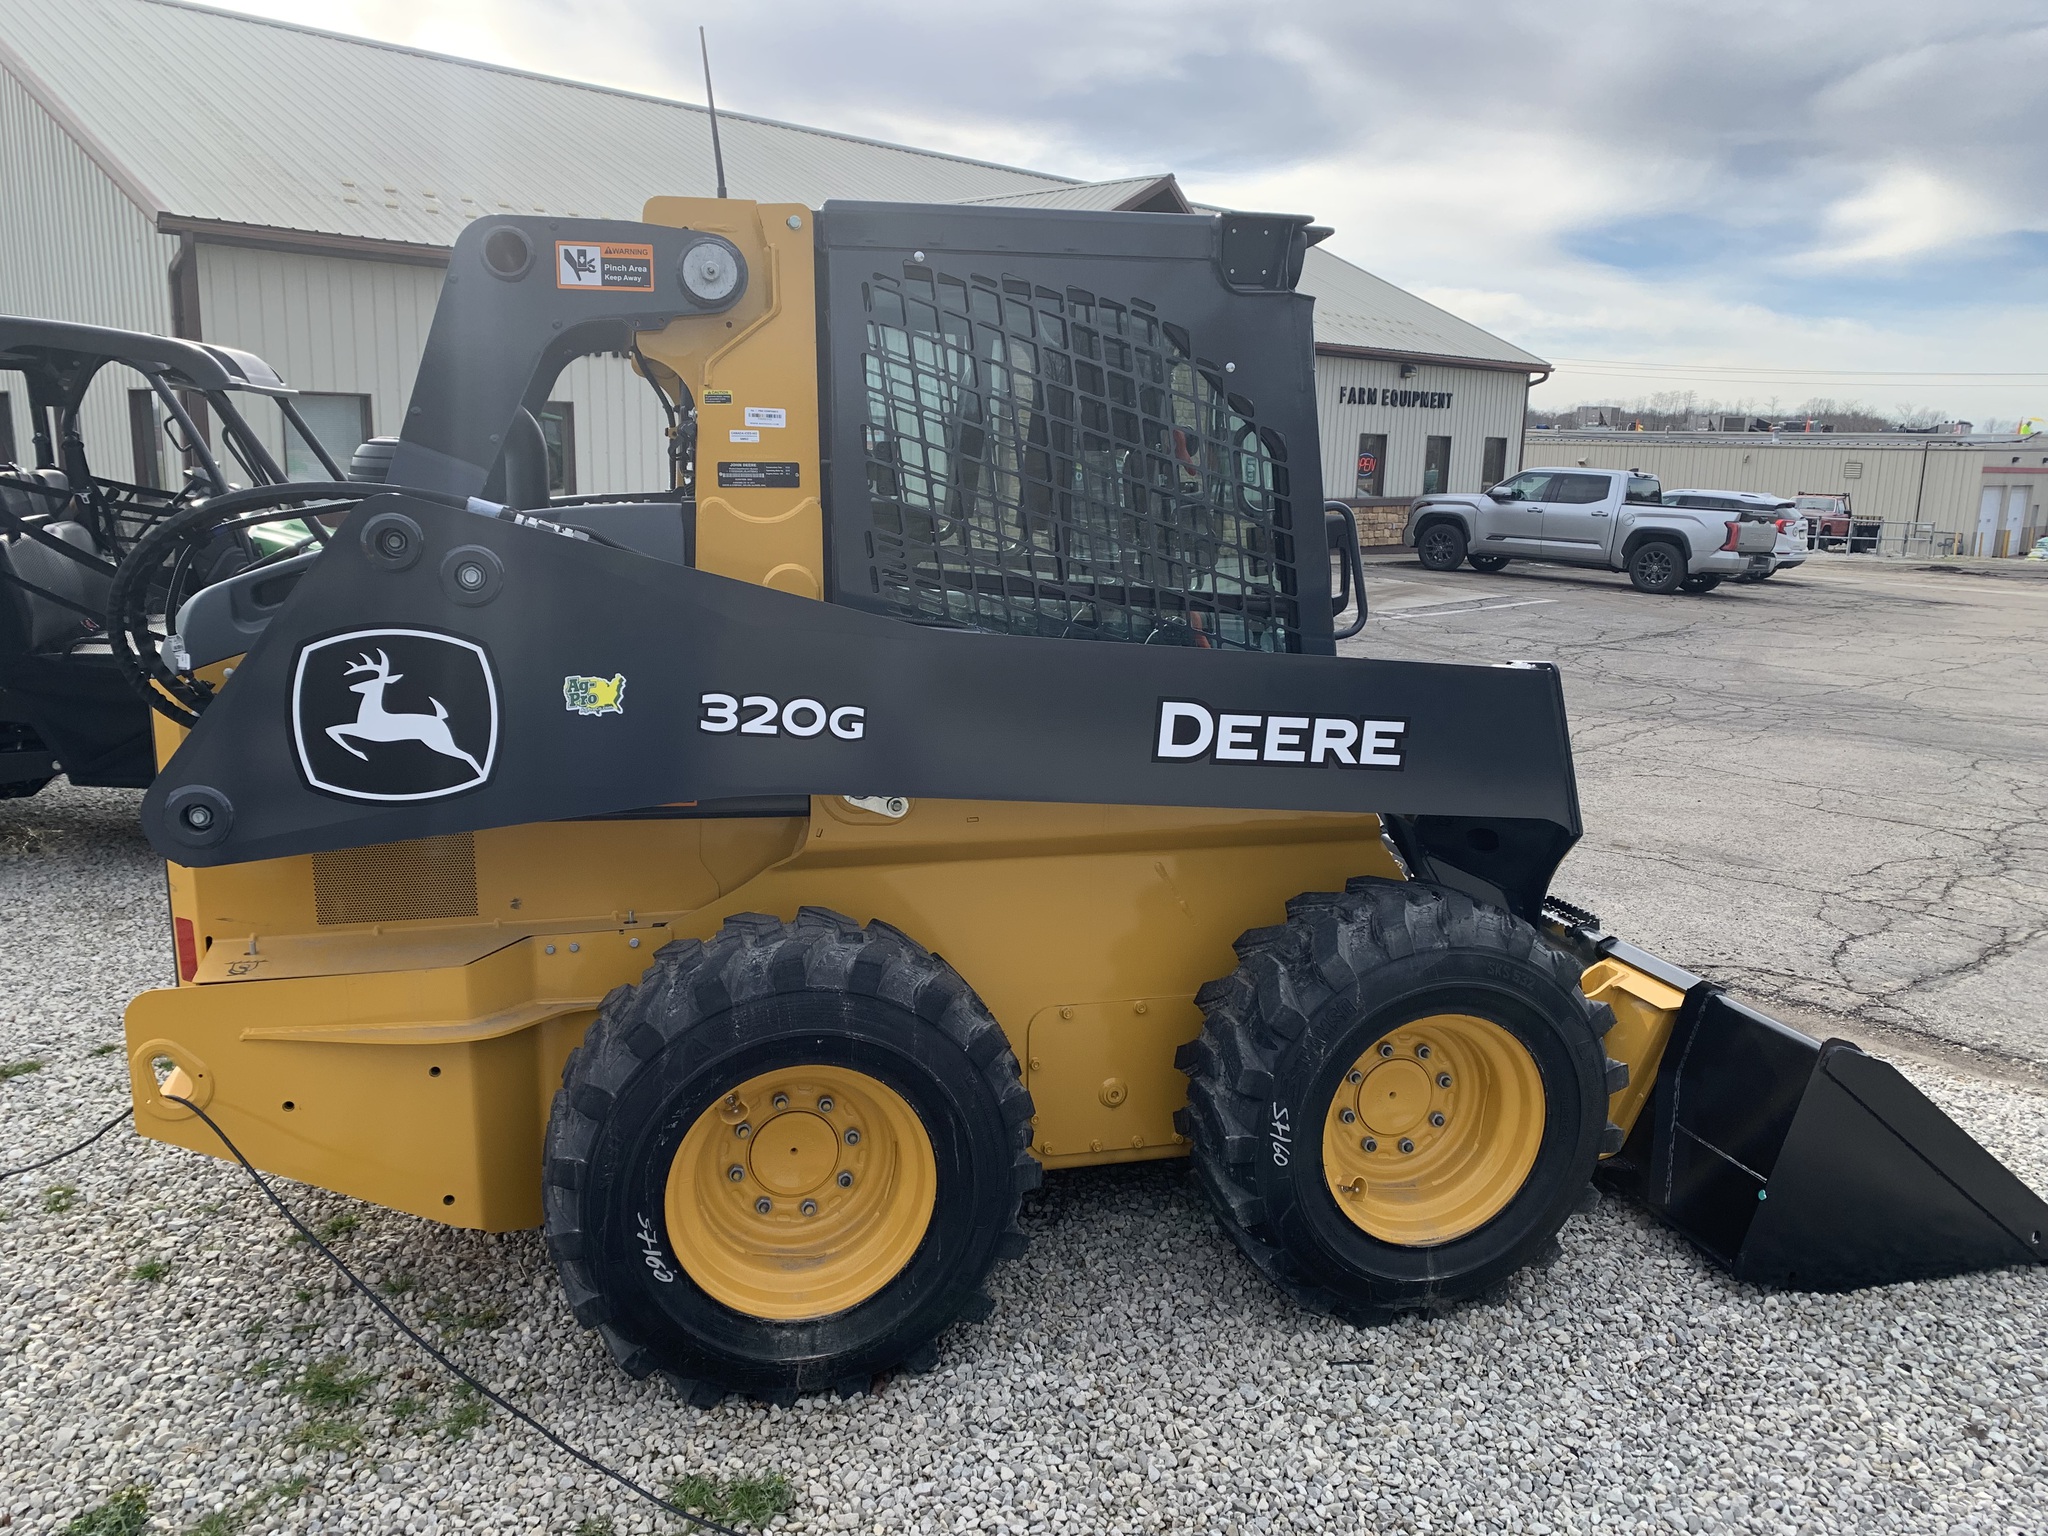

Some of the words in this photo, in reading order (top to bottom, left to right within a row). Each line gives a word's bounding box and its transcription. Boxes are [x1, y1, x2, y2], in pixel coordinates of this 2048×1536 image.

[612, 248, 648, 256] WARNING
[604, 264, 627, 272] Pinch
[629, 265, 648, 273] Area
[604, 274, 622, 282] Keep
[623, 274, 642, 283] Away
[1339, 386, 1378, 405] FARM
[1381, 388, 1453, 409] EQUIPMENT
[1358, 457, 1376, 472] PEN
[568, 679, 596, 695] Ag-
[569, 692, 598, 707] Pro
[700, 693, 865, 740] 320G
[1157, 701, 1406, 766] DEERE
